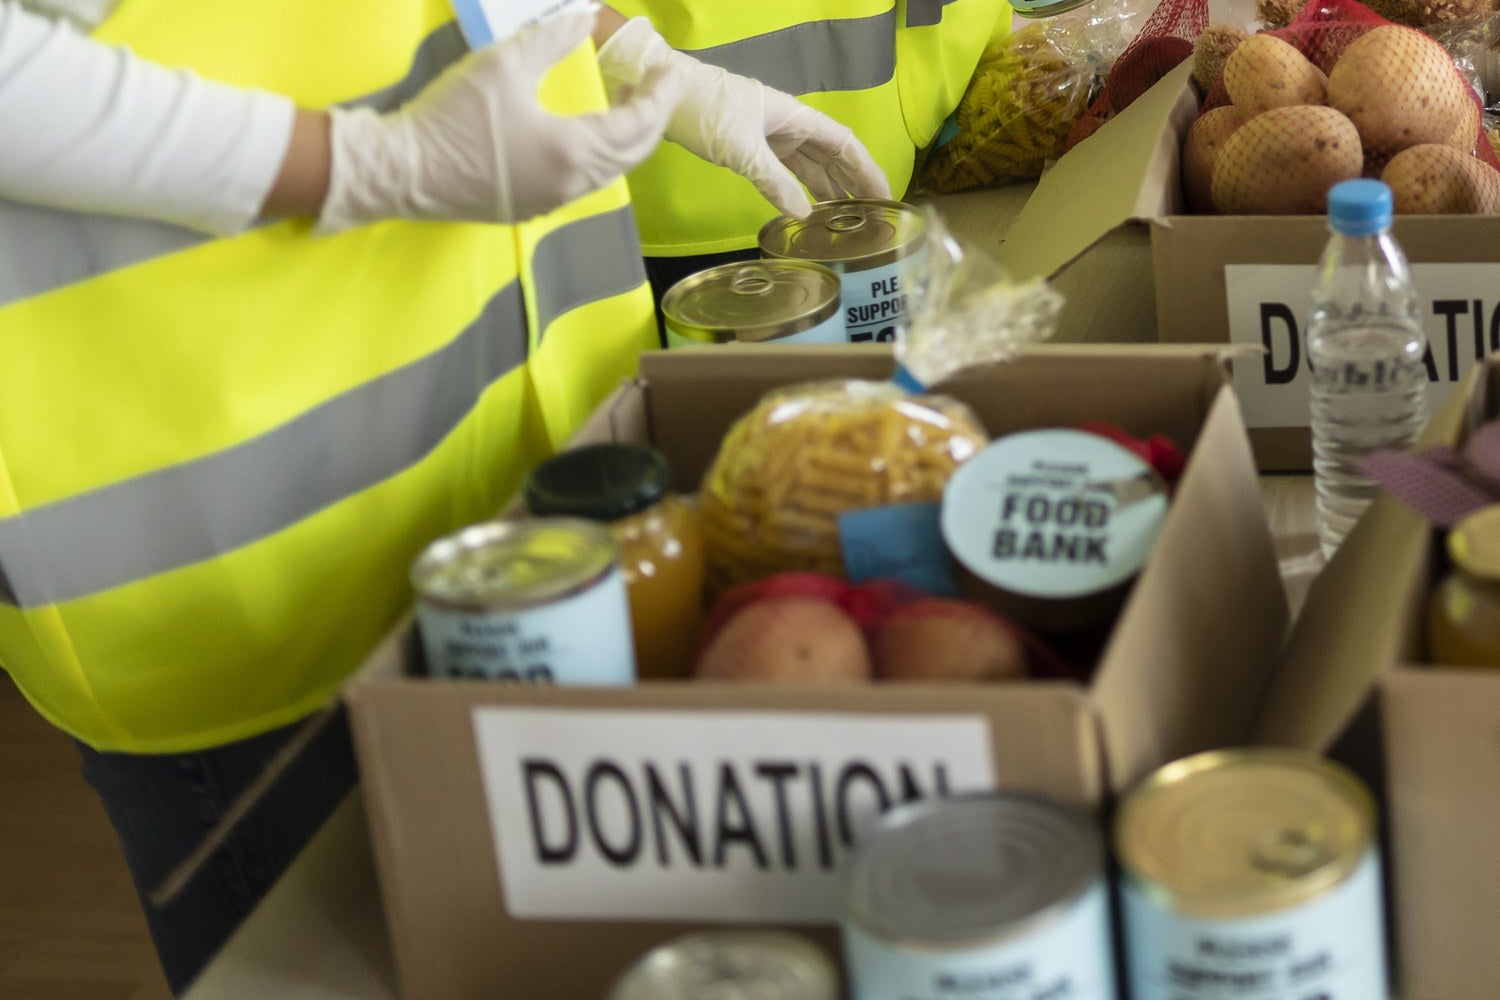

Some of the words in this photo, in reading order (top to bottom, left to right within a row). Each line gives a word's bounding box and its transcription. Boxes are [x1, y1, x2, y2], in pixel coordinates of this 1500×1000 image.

[847, 294, 908, 324] SUPPO
[1002, 494, 1109, 529] FOOD
[993, 528, 1108, 566] BANK
